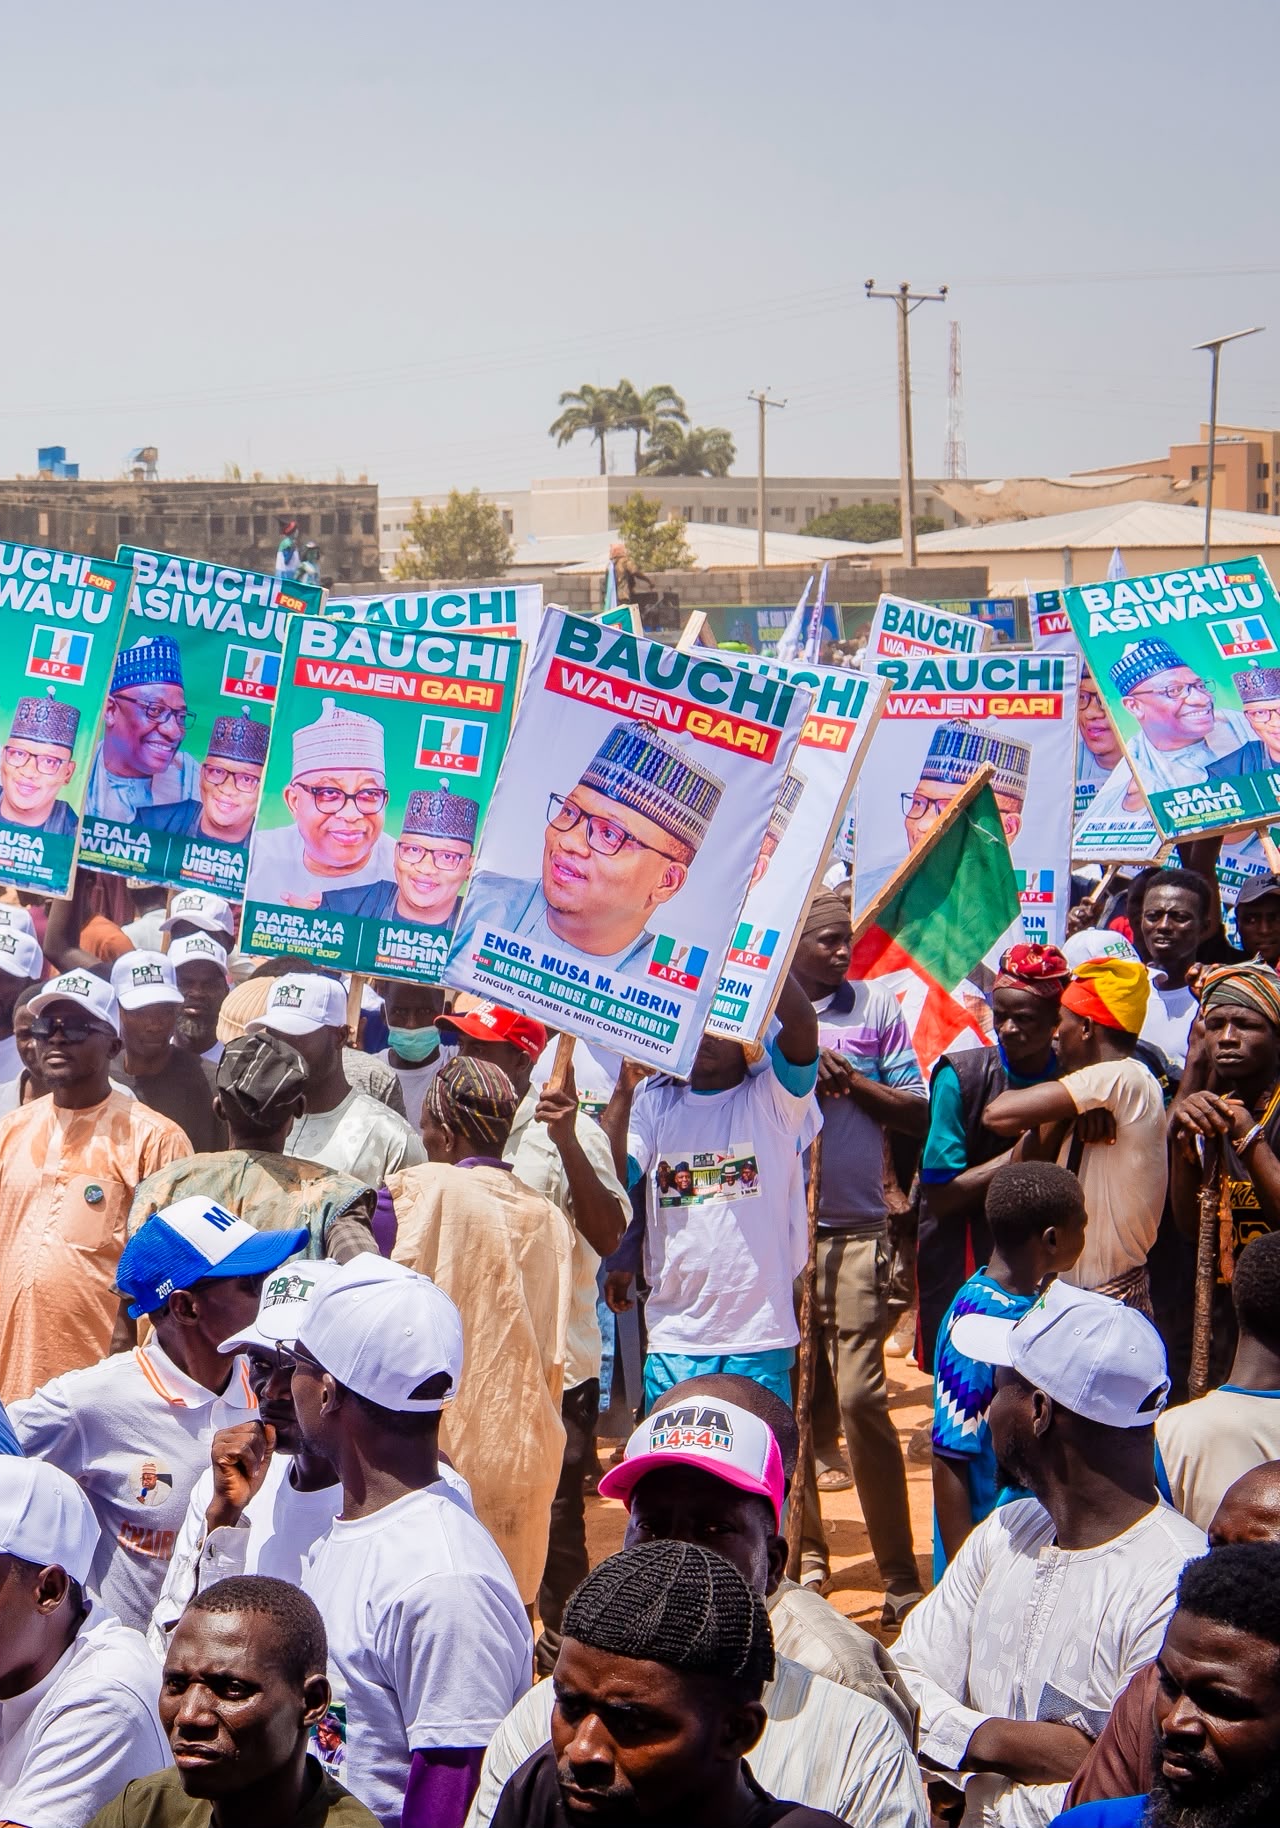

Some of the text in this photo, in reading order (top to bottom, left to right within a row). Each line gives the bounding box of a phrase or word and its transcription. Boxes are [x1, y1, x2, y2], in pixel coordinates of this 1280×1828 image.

[88, 575, 112, 590] FOR
[132, 552, 282, 608] BAUCHI
[1081, 566, 1230, 613] BAUCHI
[1229, 574, 1252, 583] FOR
[279, 595, 303, 611] FOR
[1089, 584, 1264, 637] ASIWAJU
[882, 603, 976, 653] BAUCHI
[299, 621, 510, 681] BAUCHI
[1233, 642, 1260, 653] APC
[40, 664, 70, 677] APC
[554, 615, 795, 727] BAUCHI
[877, 659, 1064, 692] BAUCHI
[234, 682, 264, 696] APC
[306, 664, 494, 707] WAJEN GARI
[561, 667, 769, 755] WAJEN GARI
[886, 698, 1055, 715] WAJEN GARI
[431, 754, 464, 768] APC
[1174, 782, 1237, 805] BALA
[1165, 794, 1242, 819] WUNTI
[93, 822, 152, 848] BALA
[80, 835, 151, 864] WUNTI
[191, 843, 245, 868] MUSA
[1020, 893, 1044, 902] APC
[253, 923, 344, 945] ABUBAKAR
[255, 910, 345, 934] BARR. M.A
[251, 940, 341, 959] BAUCHI STATE 2027
[252, 933, 323, 949] FOR GOVERNOR
[387, 927, 448, 950] MUSA
[735, 950, 761, 966] APC
[484, 932, 682, 1019] ENGR. MUSA M. JIBRIN
[657, 966, 688, 985] APC
[474, 954, 671, 1037] FOR MEMBER, HOUSE OF ASSEMBLY
[472, 973, 515, 996] ZUNGUR,
[517, 989, 563, 1014] GALAMBI
[564, 1008, 571, 1017] &
[573, 1012, 595, 1026] MIRI
[597, 1020, 672, 1055] CONSTITUENCY
[202, 1206, 239, 1232] M
[156, 1279, 175, 1300] 2027
[652, 1407, 732, 1433] MA
[667, 1429, 712, 1446] 4+4
